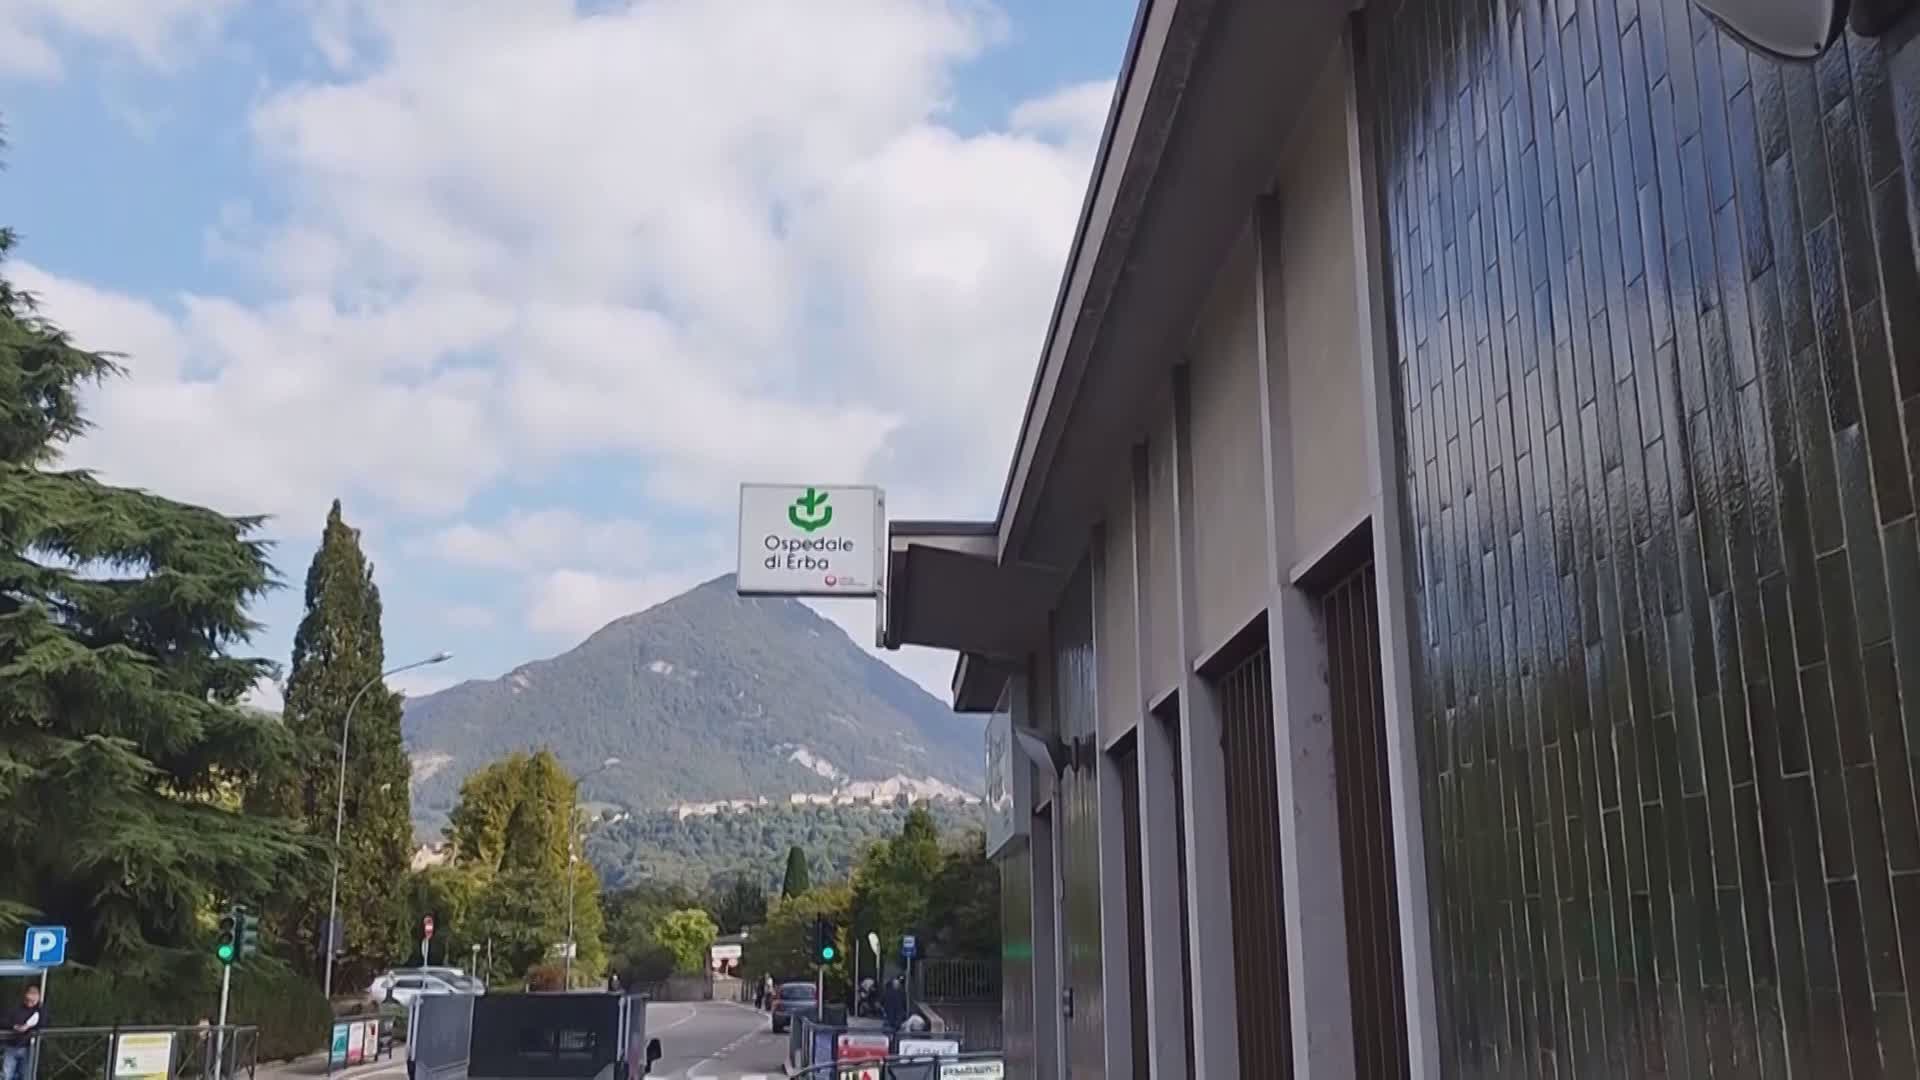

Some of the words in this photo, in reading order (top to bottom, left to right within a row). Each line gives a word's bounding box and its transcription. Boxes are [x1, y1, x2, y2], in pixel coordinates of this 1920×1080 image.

[765, 535, 854, 552] Ospedale
[765, 555, 781, 570] di
[787, 555, 829, 570] Erba
[32, 931, 57, 960] P
